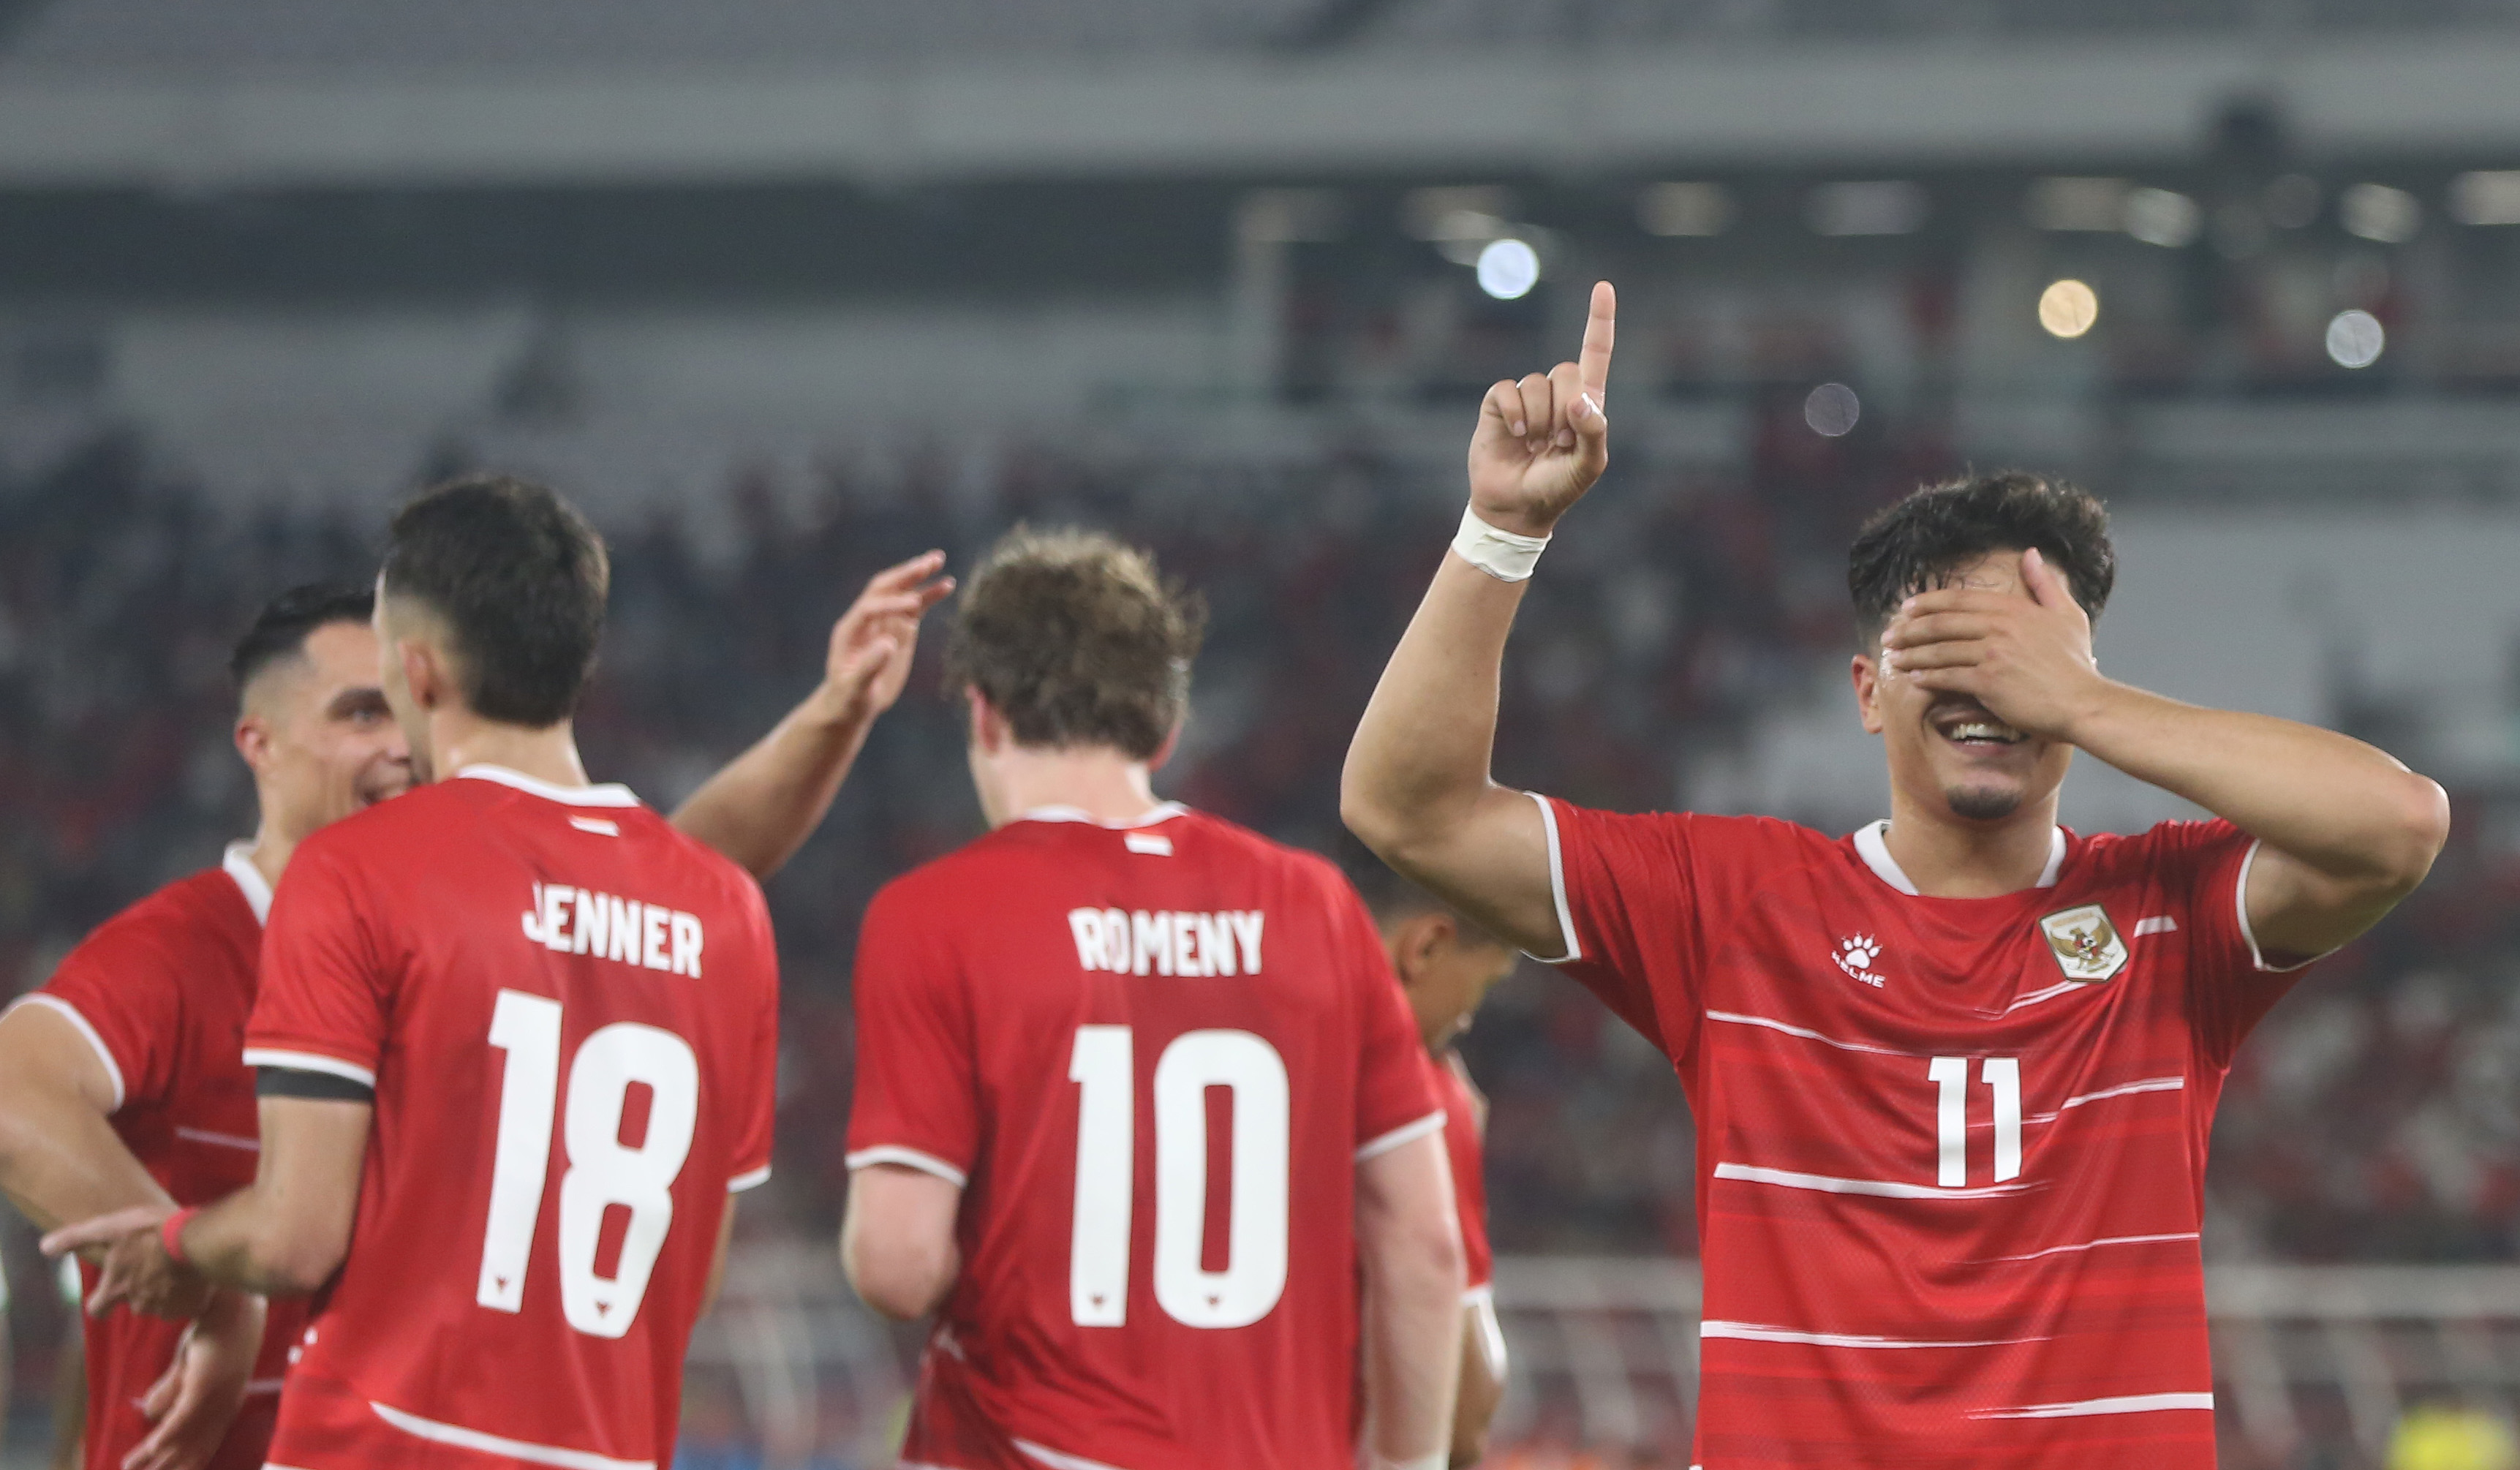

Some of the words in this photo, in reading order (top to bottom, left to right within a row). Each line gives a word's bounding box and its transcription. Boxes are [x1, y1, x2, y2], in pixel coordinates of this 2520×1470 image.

[521, 881, 703, 979] JENNER
[1068, 907, 1264, 977] ROMENY
[477, 987, 699, 1338] 18
[1068, 1025, 1290, 1329] 10
[1928, 1056, 2022, 1188] 11
